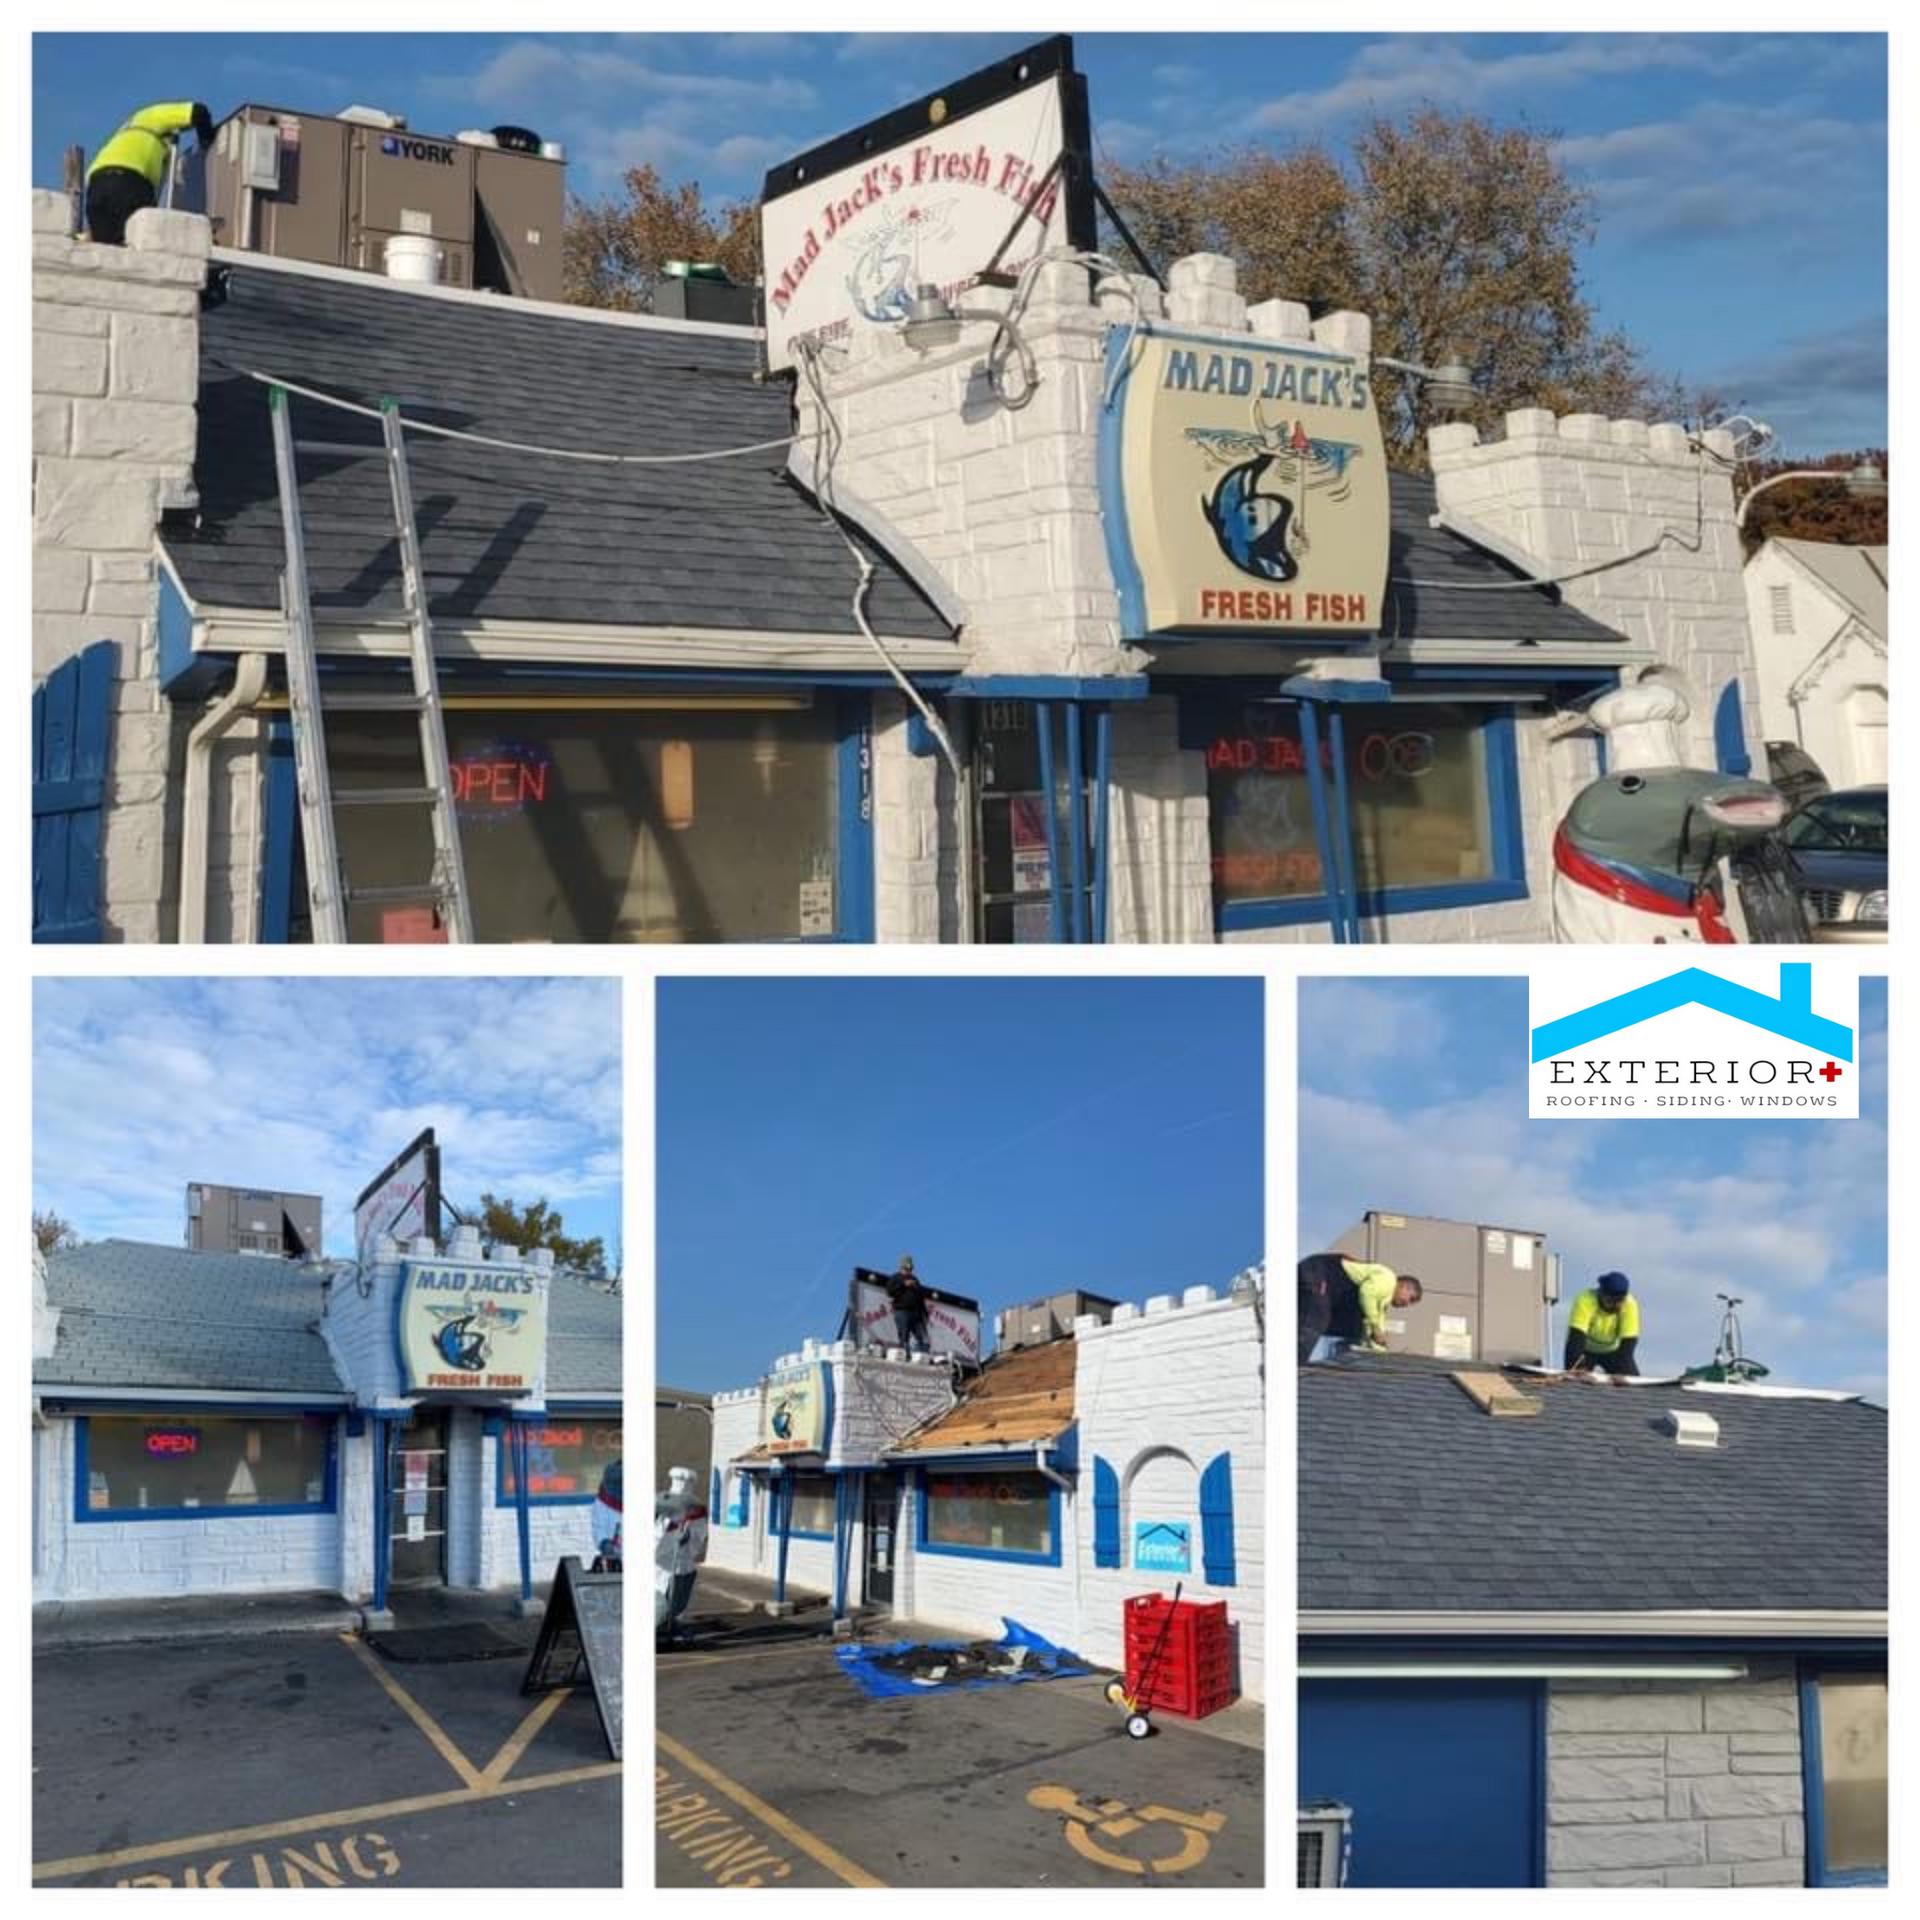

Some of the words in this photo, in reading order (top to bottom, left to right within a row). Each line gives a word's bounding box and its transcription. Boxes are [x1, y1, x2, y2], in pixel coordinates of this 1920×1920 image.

[400, 139, 455, 166] YORK
[769, 229, 821, 319] Mad
[822, 160, 904, 239] Jack's
[909, 145, 991, 184] Fresh
[1164, 350, 1253, 396] MAD
[1260, 361, 1367, 410] JACK'S
[1201, 589, 1292, 620] FRESH
[1305, 592, 1366, 622] FISH
[416, 1271, 467, 1290] MAD
[427, 1373, 481, 1386] FRESH
[486, 1374, 523, 1386] FISH
[146, 1434, 197, 1454] OPEN
